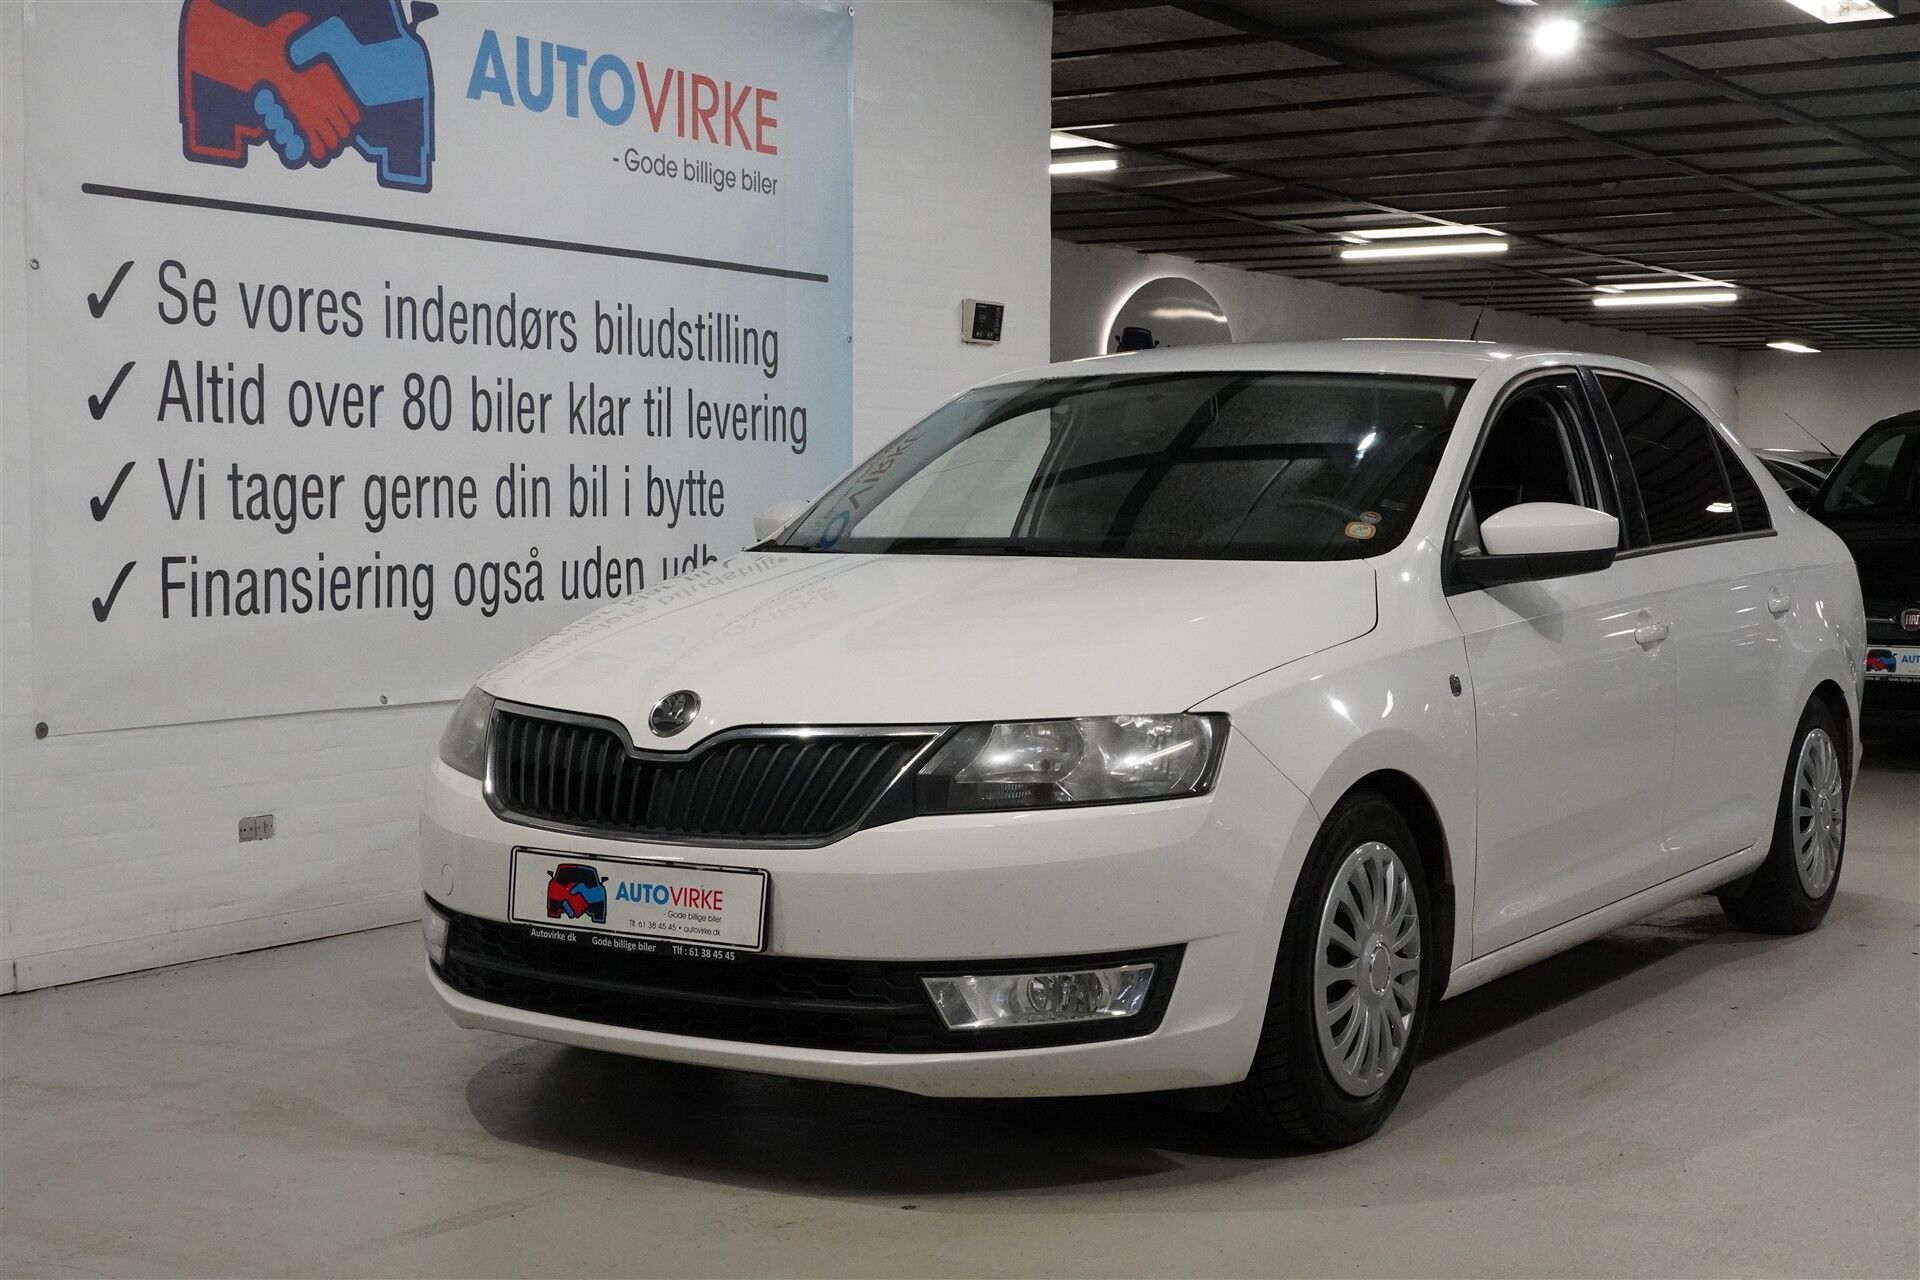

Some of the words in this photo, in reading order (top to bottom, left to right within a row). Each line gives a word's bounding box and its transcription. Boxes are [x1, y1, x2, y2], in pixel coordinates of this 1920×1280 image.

[467, 29, 777, 155] AUTOVIRKE
[625, 148, 677, 178] Gode
[684, 158, 736, 192] billige
[742, 169, 777, 195] biler
[157, 260, 217, 326] Se
[239, 283, 363, 339] vores
[385, 281, 576, 353] indendørs
[596, 300, 779, 378] biludstilling
[157, 360, 265, 426] Altid
[289, 379, 384, 429] over
[403, 373, 452, 432] 80
[472, 376, 552, 435] biler
[570, 382, 630, 437] klar
[644, 387, 672, 440] til
[688, 388, 808, 454] levering
[158, 458, 205, 521] Vi
[227, 463, 345, 534] tager
[364, 475, 477, 534] gerne
[496, 463, 551, 519] din
[570, 464, 608, 518] bil
[625, 465, 630, 517] i
[648, 465, 725, 528] bytte
[162, 556, 433, 621] Finansiering
[455, 547, 545, 617] også
[562, 546, 645, 601] uden
[616, 881, 723, 911] AUTOVIRKE
[667, 910, 687, 920] Gode
[592, 936, 612, 948] Gode
[613, 938, 637, 952] billige
[638, 941, 657, 953] biler
[638, 920, 646, 928] 61
[648, 921, 657, 930] 38
[658, 922, 667, 931] 45
[668, 923, 677, 932] 45
[689, 947, 699, 957] 61
[702, 949, 711, 959] 38
[713, 950, 723, 960] 45
[725, 951, 735, 961] 45
